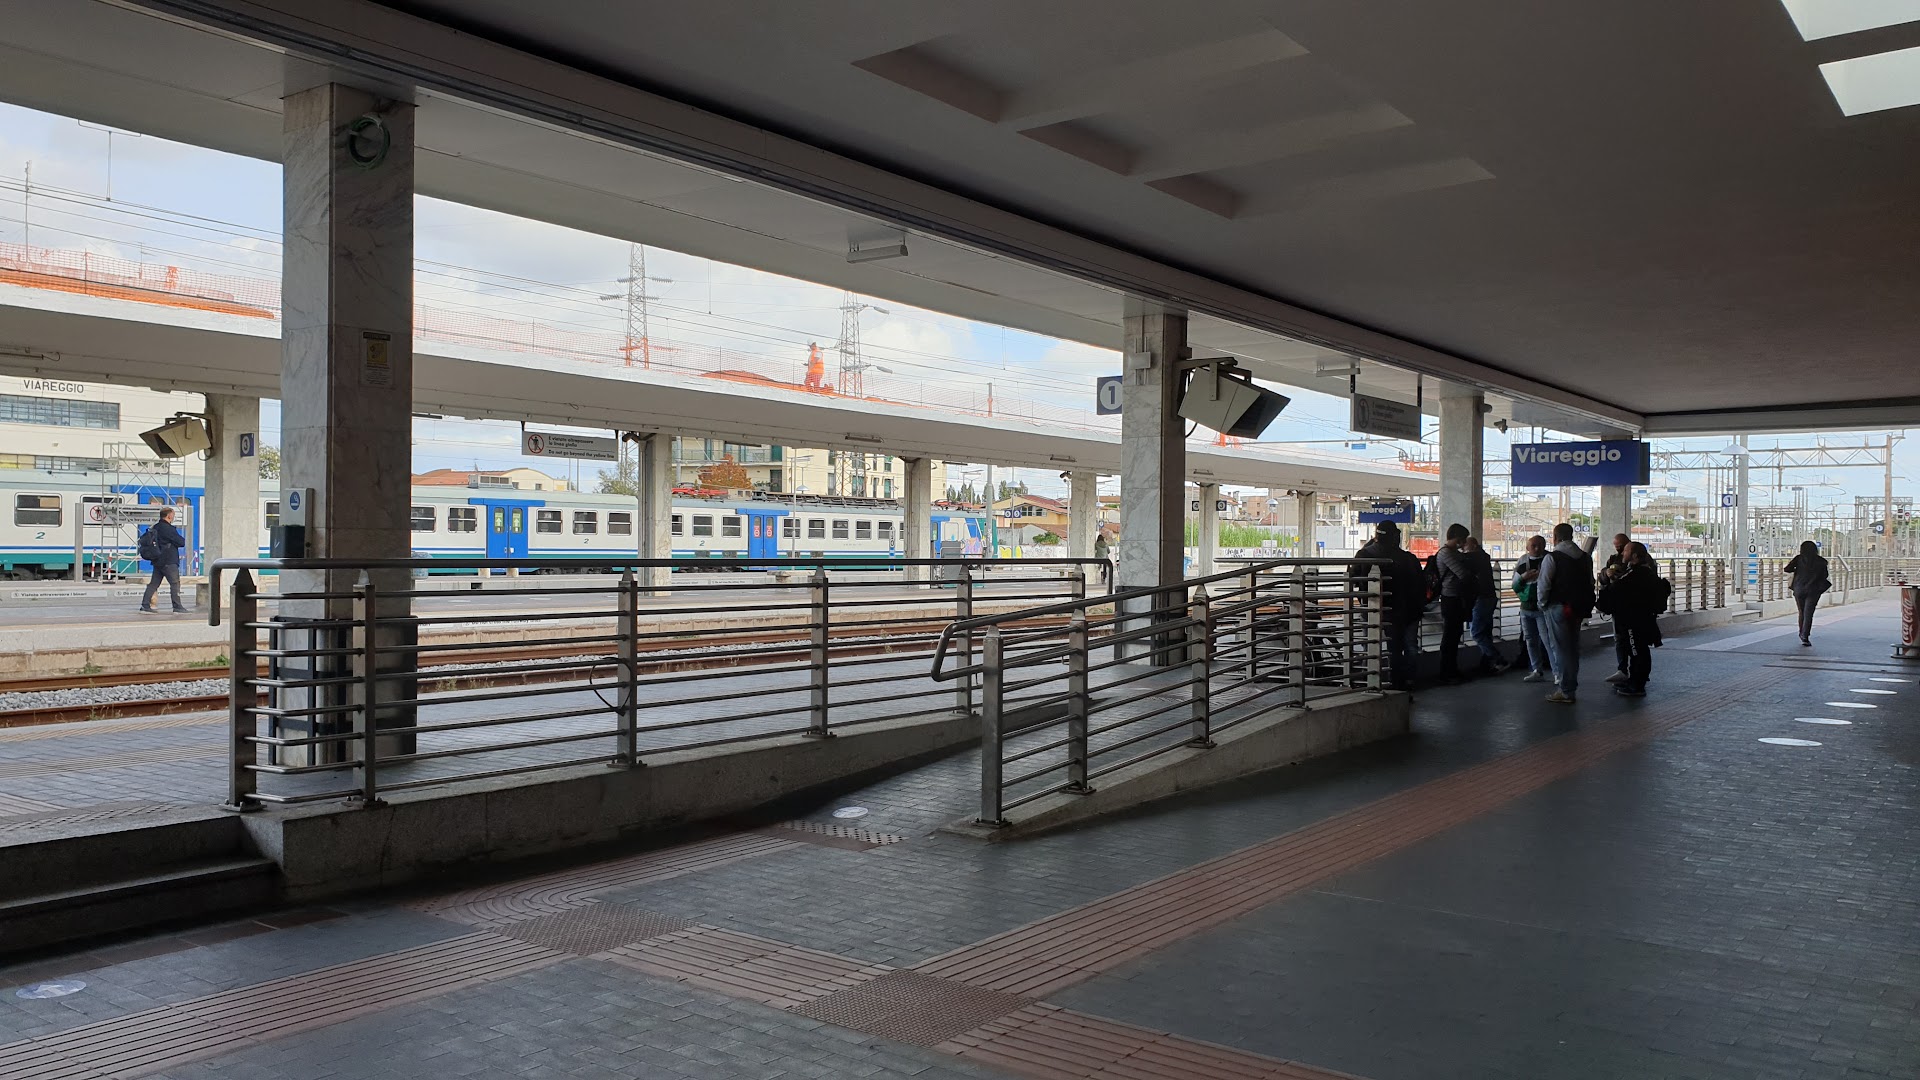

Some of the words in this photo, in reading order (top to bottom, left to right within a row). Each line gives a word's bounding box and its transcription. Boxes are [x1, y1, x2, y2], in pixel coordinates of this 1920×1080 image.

[23, 379, 84, 394] VIAREGGIO
[1108, 385, 1116, 405] 1
[1515, 445, 1621, 466] Viareggio
[1361, 505, 1404, 515] areggio
[35, 531, 46, 540] 2
